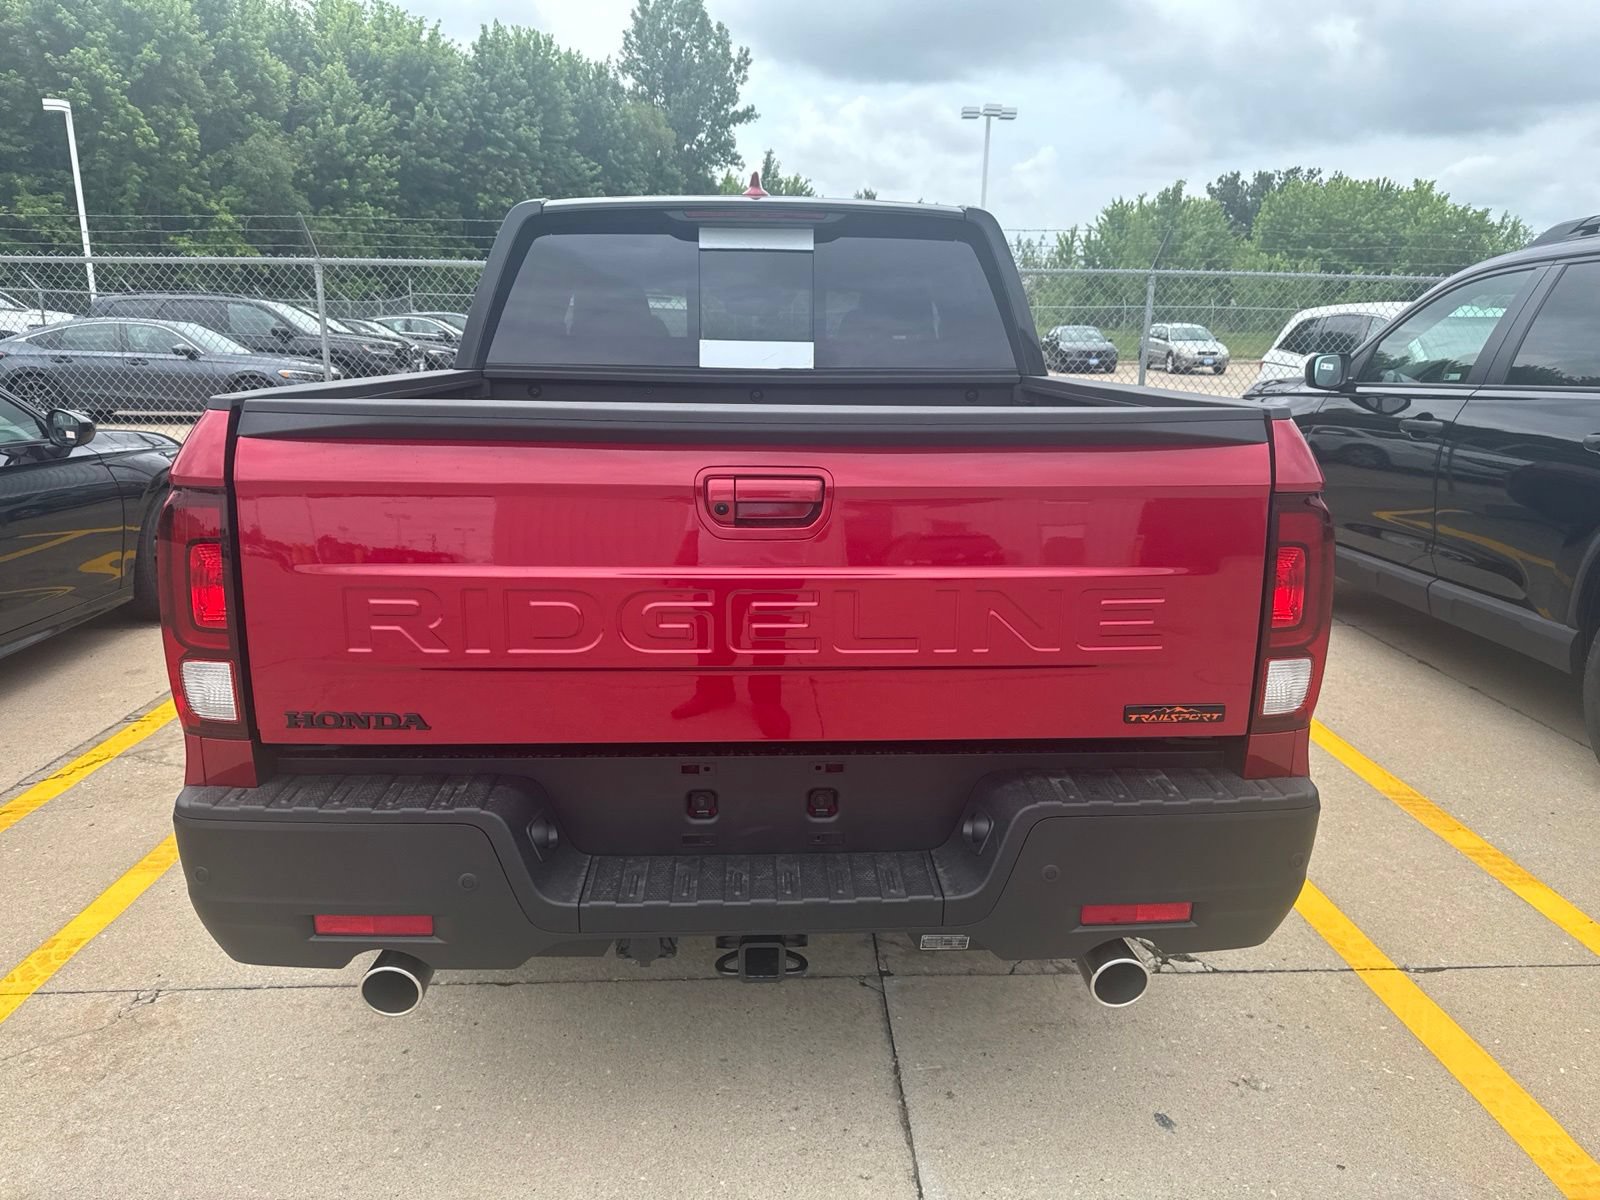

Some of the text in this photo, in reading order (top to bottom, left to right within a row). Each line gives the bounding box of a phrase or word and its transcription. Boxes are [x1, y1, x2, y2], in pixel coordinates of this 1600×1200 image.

[343, 587, 1166, 655] RIDGELINE
[285, 711, 432, 730] HONDA
[1128, 713, 1222, 722] TRAILSPORT
